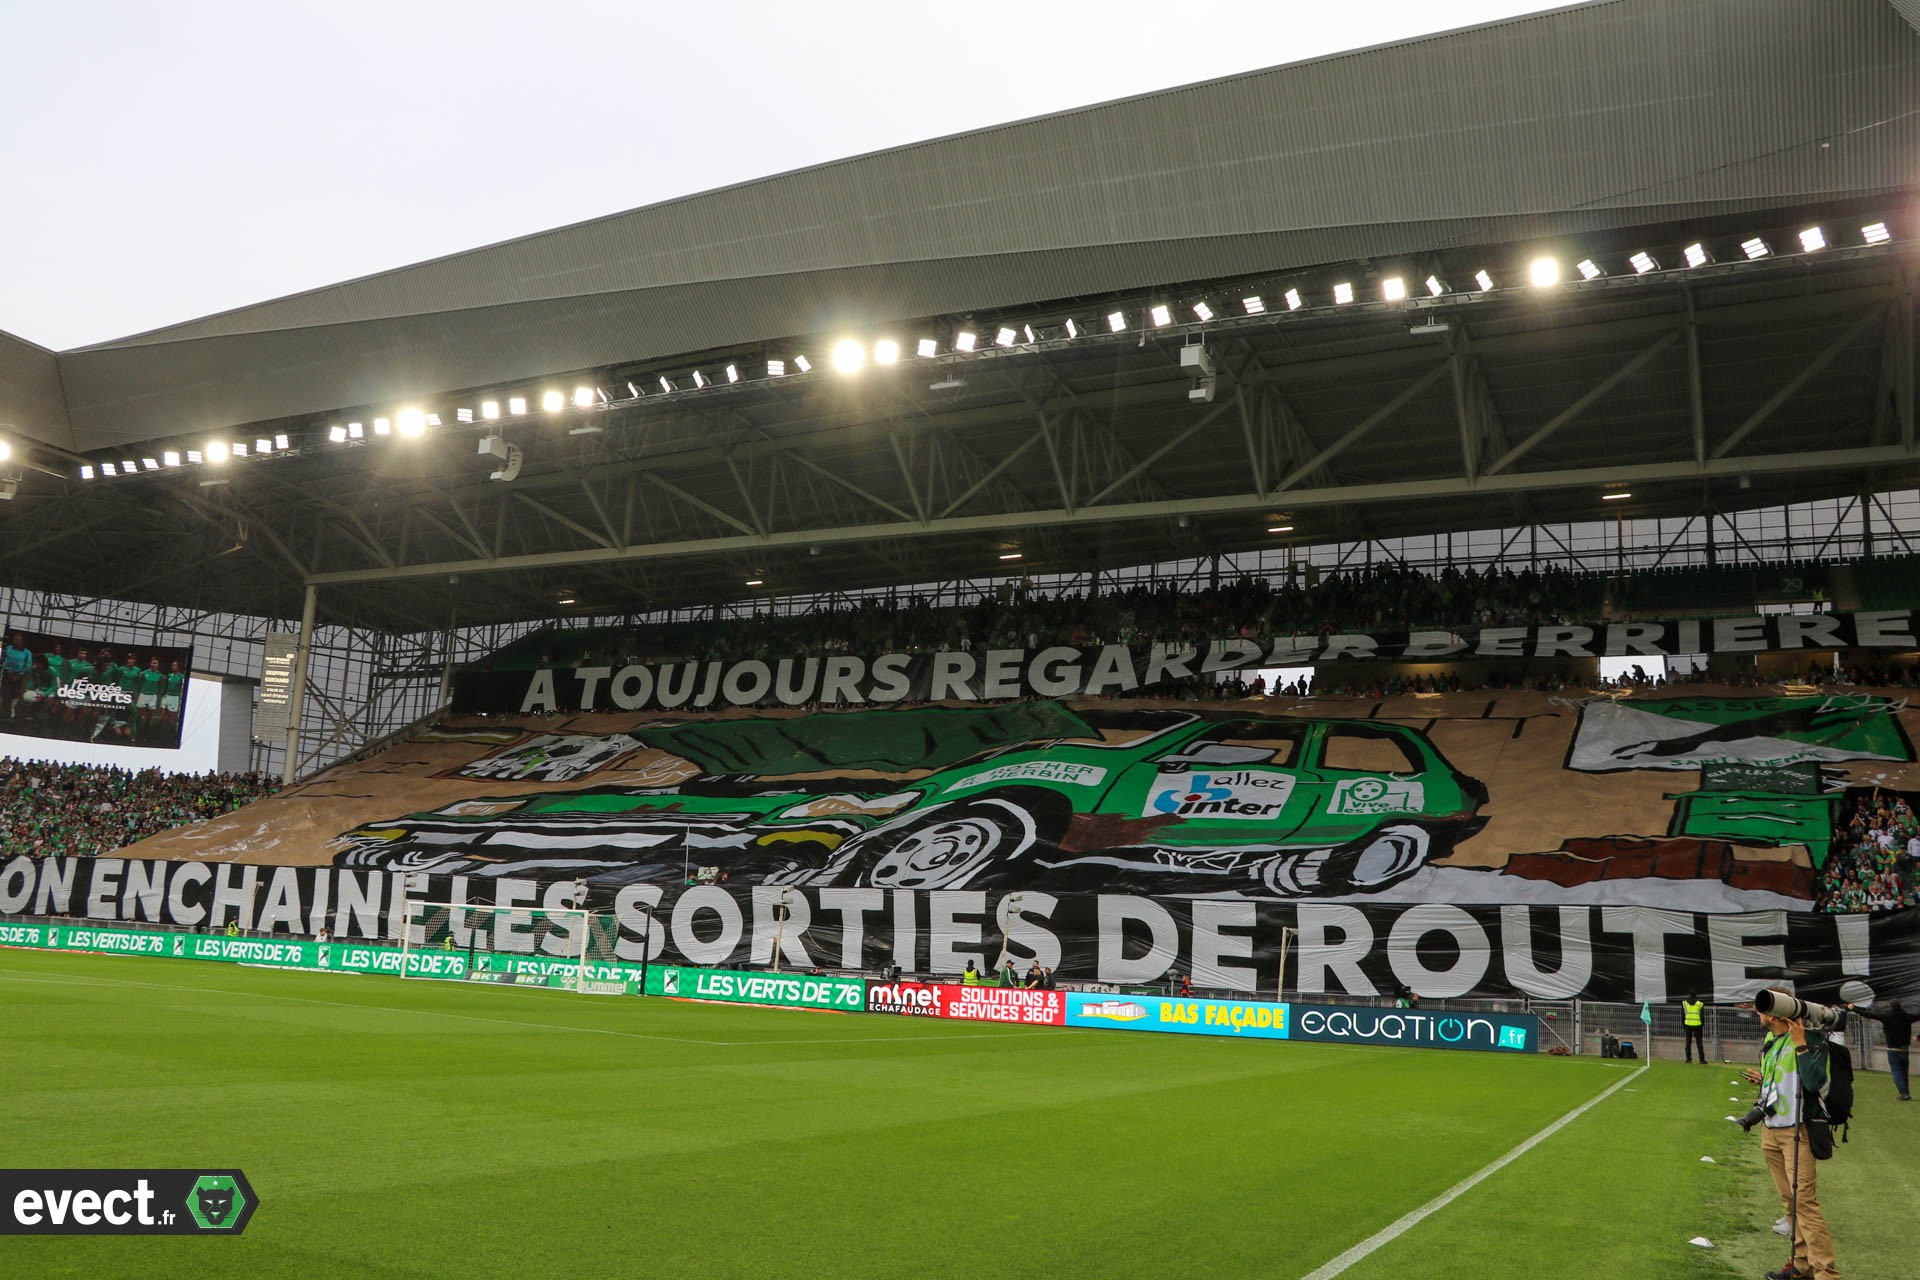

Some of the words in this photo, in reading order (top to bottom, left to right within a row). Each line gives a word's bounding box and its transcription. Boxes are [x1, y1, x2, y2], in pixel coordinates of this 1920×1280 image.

[519, 669, 558, 712] A
[573, 653, 914, 711] TOUJOURS
[930, 633, 1380, 701] REGARDER
[1402, 609, 1917, 657] DERRIERE
[57, 684, 86, 699] des
[90, 690, 133, 704] verts
[1662, 701, 1784, 713] ASSE
[991, 762, 1094, 775] ROCHER
[991, 769, 1080, 781] HERBIN
[1213, 771, 1286, 790] allez
[1178, 794, 1283, 816] inter
[0, 855, 78, 915] ON
[87, 859, 430, 944] ENCHAINE
[448, 875, 592, 958] LES
[614, 884, 1063, 979] SORTIES
[1097, 893, 1257, 992] DE
[1296, 902, 1796, 1004] ROUTE
[8, 927, 26, 943] DE
[26, 928, 40, 944] 76
[67, 930, 92, 947] LES
[91, 932, 129, 950] VERTS
[127, 935, 148, 951] DE
[147, 936, 164, 953] 76
[195, 939, 220, 957] LES
[219, 941, 260, 961] VERTS
[258, 944, 284, 962] DE
[281, 945, 303, 964] 76
[341, 949, 373, 969] LES
[371, 951, 420, 972] VERTS
[420, 954, 445, 973] DE
[441, 956, 464, 975] 76
[471, 971, 502, 982] BKT
[515, 973, 547, 985] BKT
[696, 974, 735, 998] LES
[733, 977, 802, 1002] VERTS
[803, 981, 833, 1003] DE
[831, 983, 862, 1005] 76
[961, 988, 1043, 1007] SOLUTIONS
[1051, 993, 1059, 1007] &
[869, 1003, 941, 1016] ECHAFAUDAGE
[949, 1001, 1019, 1020] SERVICES
[1160, 1002, 1199, 1024] BAS
[1205, 1005, 1284, 1032] FAÇADE
